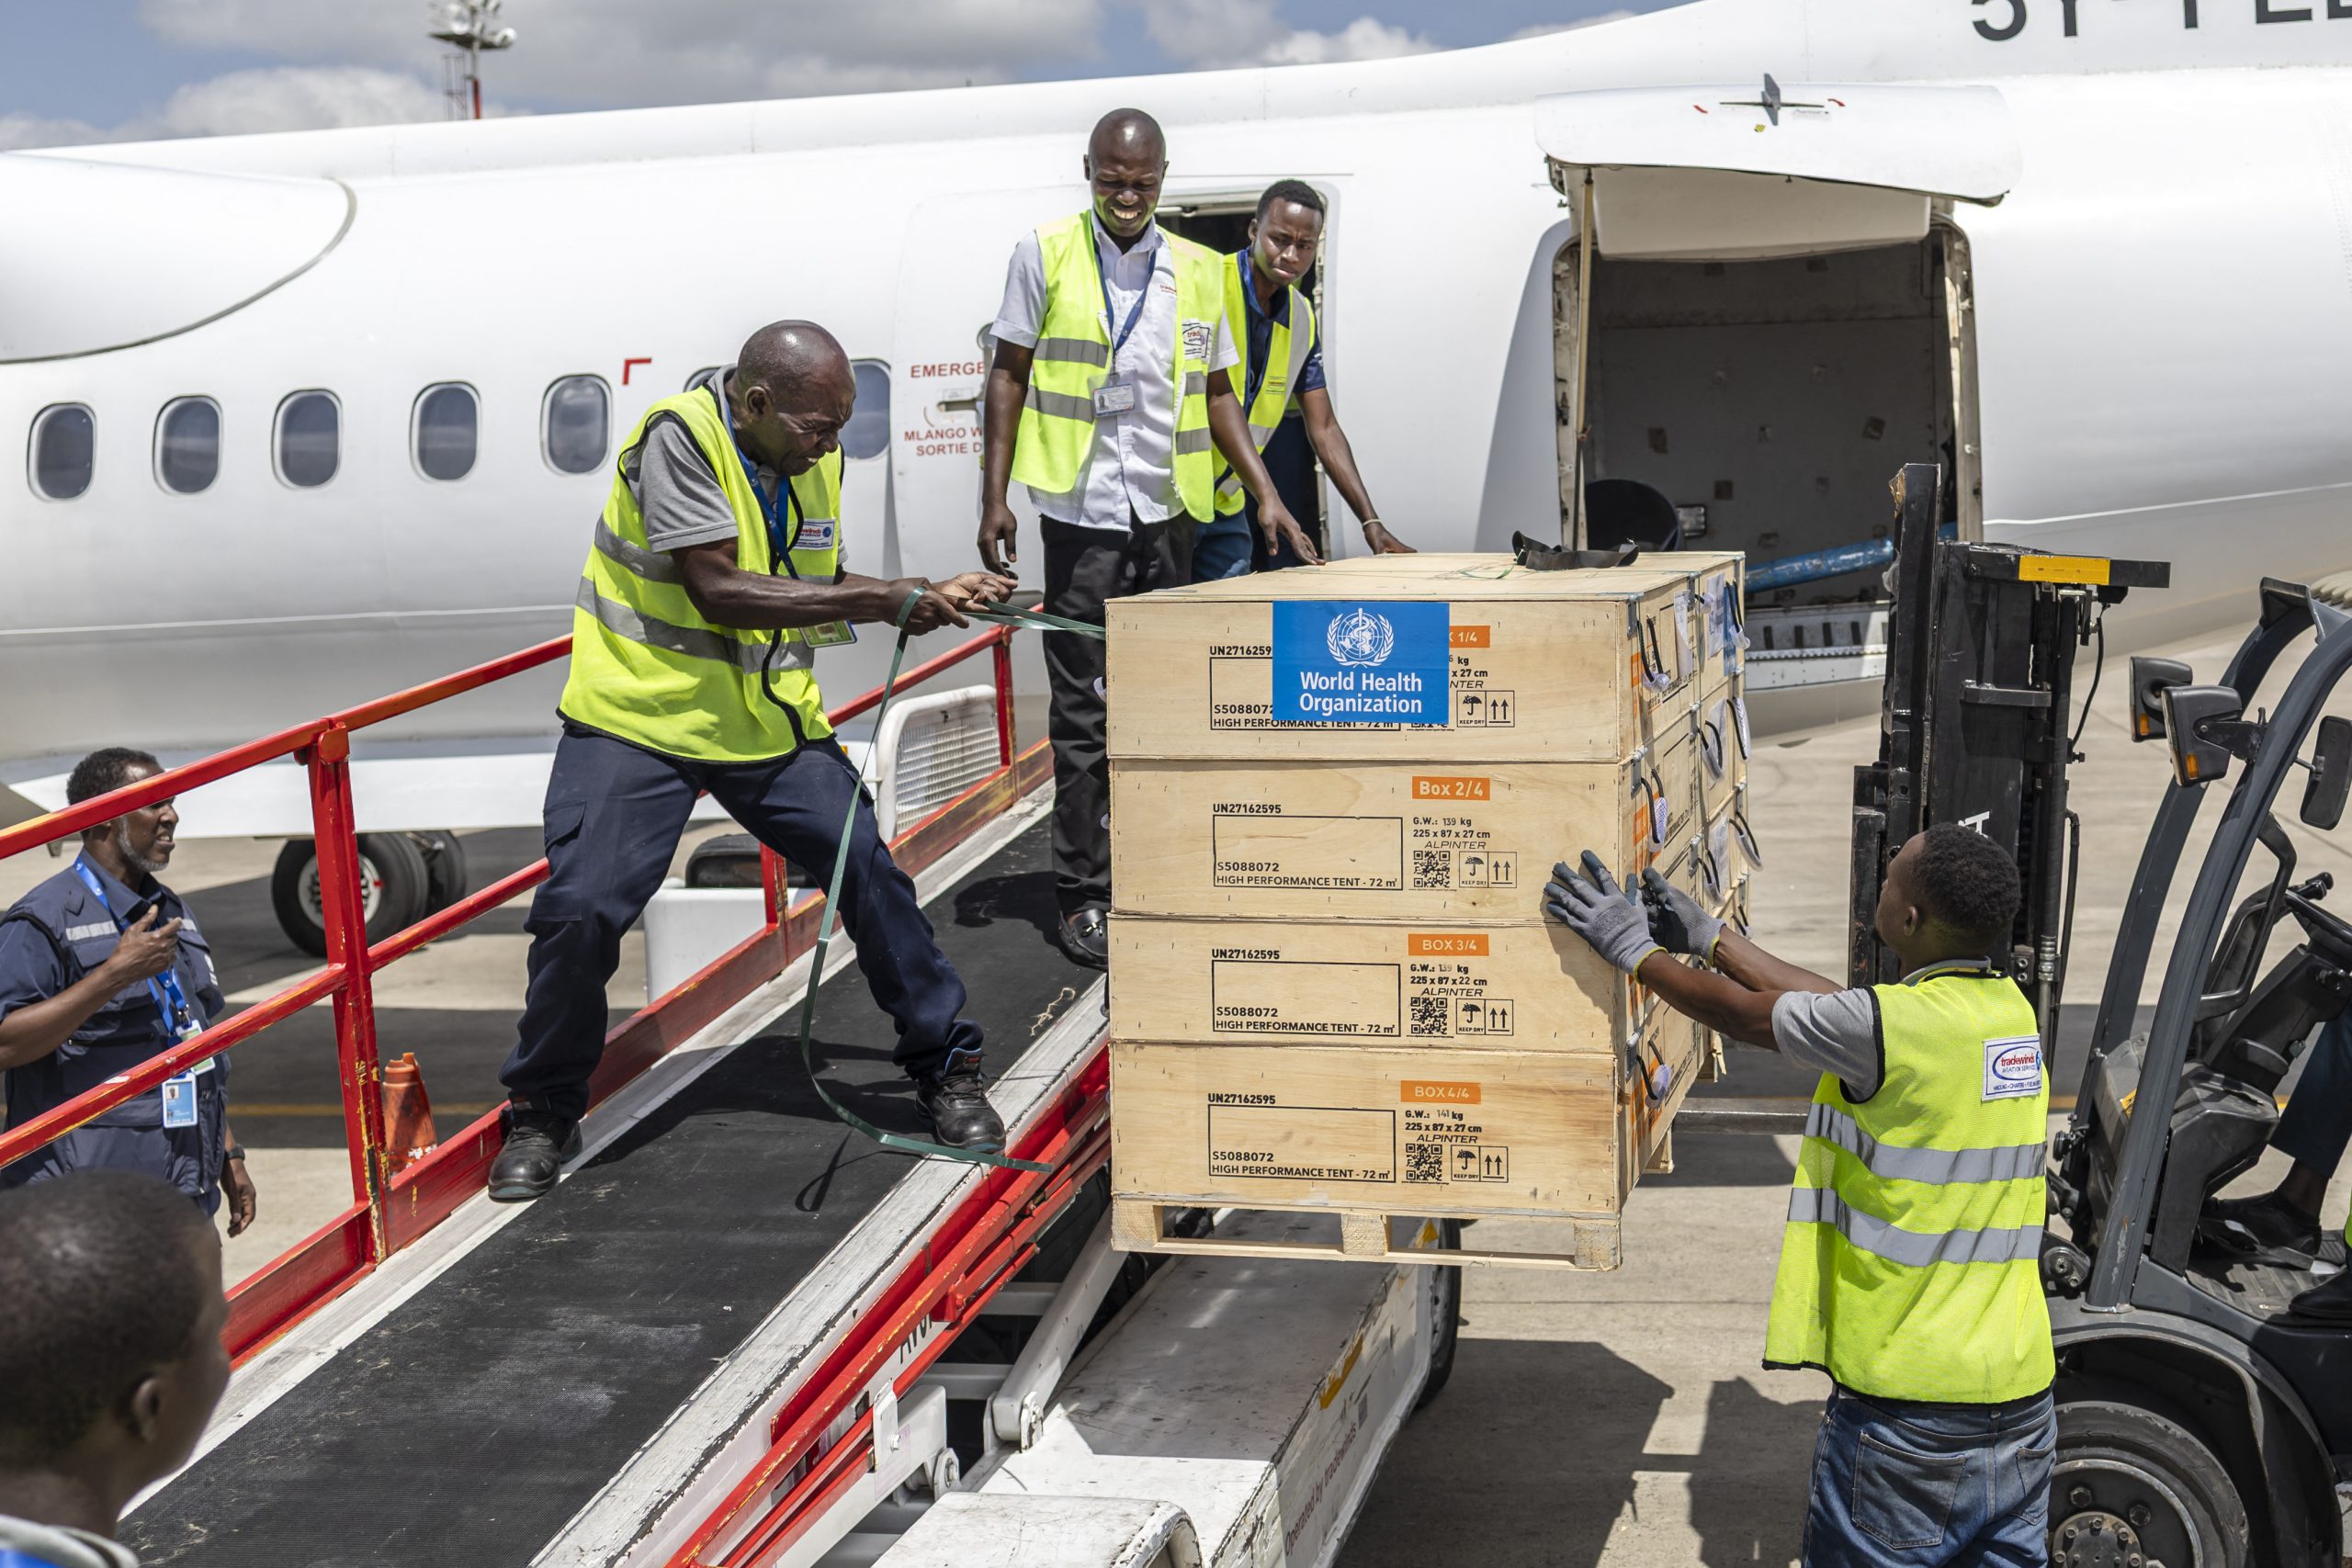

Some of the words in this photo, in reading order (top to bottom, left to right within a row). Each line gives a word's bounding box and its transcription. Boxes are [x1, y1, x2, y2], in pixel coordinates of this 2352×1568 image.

[904, 427, 966, 441] MLANGO
[916, 443, 967, 457] SORTIE
[1458, 631, 1478, 643] 1/4
[1457, 657, 1469, 666] kg
[1460, 669, 1471, 677] 27
[1300, 671, 1354, 690] World
[1362, 672, 1422, 692] Health
[1300, 693, 1422, 716] Organization
[1214, 718, 1241, 728] HIGH
[1244, 719, 1328, 728] PERFORMANCE
[1419, 781, 1451, 795] Box
[1455, 781, 1484, 797] 2/4
[1213, 804, 1282, 814] UN27162595
[1413, 817, 1438, 825] G.W.:
[1442, 818, 1456, 826] 139
[1460, 818, 1472, 827] kg
[1413, 829, 1430, 838] 225
[1441, 829, 1452, 838] 87
[1424, 840, 1487, 850] ALPINTER
[1217, 862, 1280, 872] S5088072
[1216, 875, 1244, 885] HIGH
[1247, 876, 1330, 886] PERFORMANCE
[1332, 877, 1361, 886] TENT
[1369, 878, 1383, 887] 72
[1422, 940, 1453, 951] BOX
[1456, 940, 1477, 951] 3/4
[1212, 949, 1280, 960] UN27162595
[1410, 964, 1435, 972] G.W.:
[1457, 964, 1469, 974] kg
[1410, 976, 1428, 985] 225
[1438, 976, 1449, 985] 87
[1459, 976, 1470, 985] 22
[1420, 987, 1484, 997] ALPINTER
[1216, 1007, 1279, 1018] S5088072
[1216, 1021, 1243, 1030] HIGH
[1246, 1021, 1329, 1032] PERFORMANCE
[1330, 1022, 1359, 1032] TENT
[1367, 1024, 1381, 1033] 72
[2001, 1054, 2035, 1066] tradewinds
[1415, 1086, 1445, 1098] BOX
[1448, 1088, 1470, 1099] 4/4
[1208, 1093, 1276, 1104] UN27162595
[1405, 1110, 1430, 1118] G.W.:
[1452, 1111, 1464, 1121] kg
[1405, 1122, 1422, 1131] 225
[1432, 1123, 1444, 1132] 87
[1416, 1134, 1478, 1144] ALPINTER
[1212, 1151, 1274, 1162] S5088072
[1212, 1165, 1239, 1174] HIGH
[1242, 1166, 1324, 1178] PERFORMANCE
[1326, 1168, 1354, 1179] TENT
[1363, 1170, 1376, 1179] 72
[1285, 1491, 1316, 1557] Operated
[1316, 1476, 1324, 1506] by
